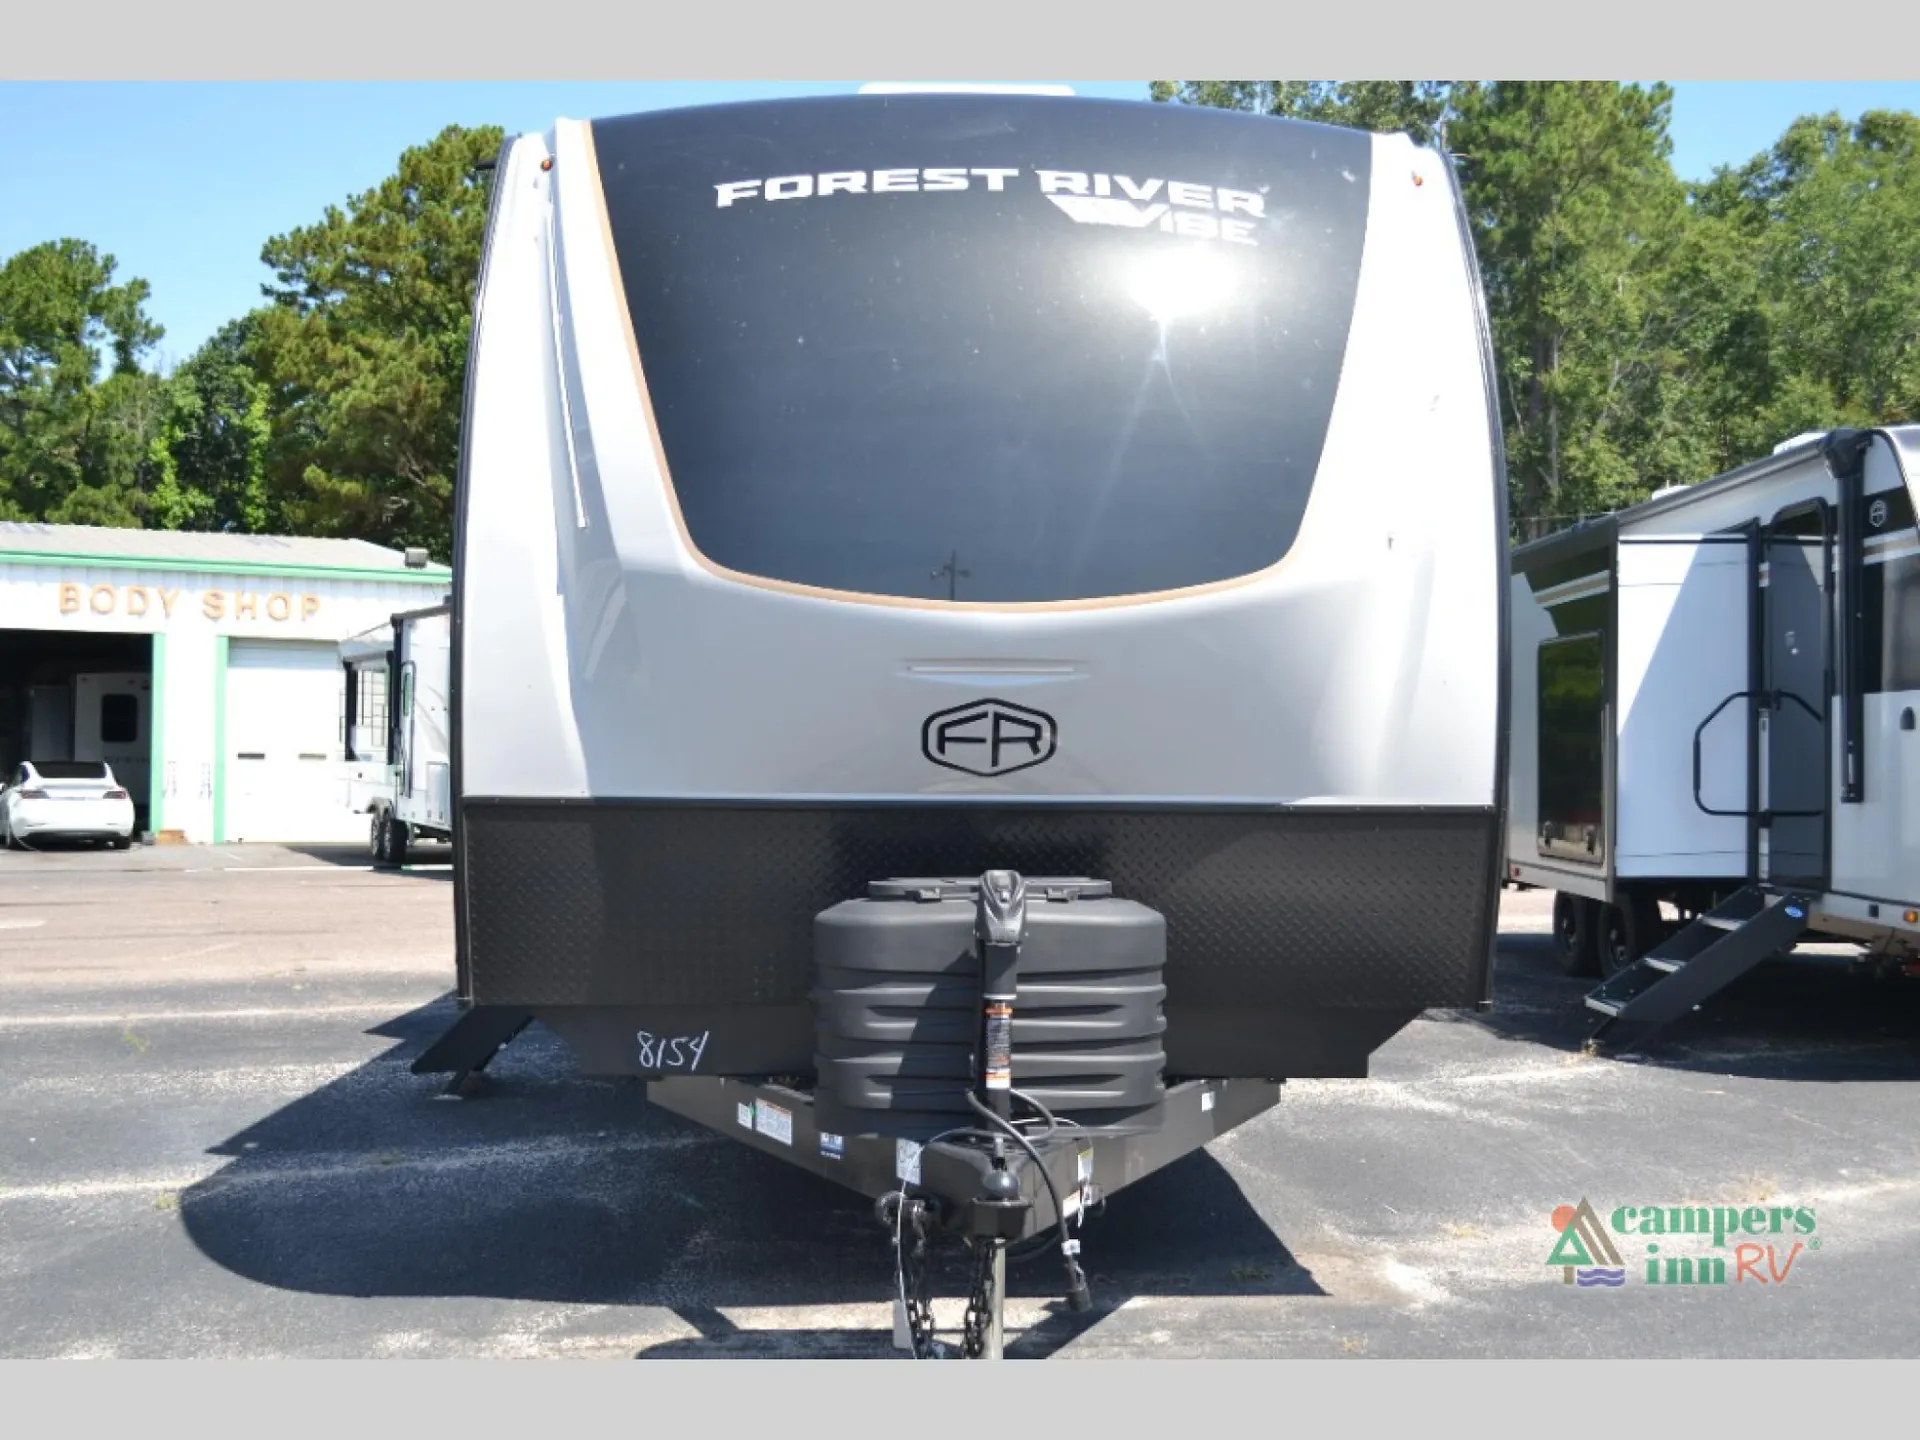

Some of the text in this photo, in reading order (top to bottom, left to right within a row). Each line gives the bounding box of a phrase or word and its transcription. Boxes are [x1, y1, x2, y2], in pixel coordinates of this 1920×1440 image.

[714, 167, 1267, 218] FOREST RIVER
[1046, 195, 1259, 246] VIBE
[59, 582, 321, 622] BODY SHOP
[637, 1030, 710, 1071] 8154
